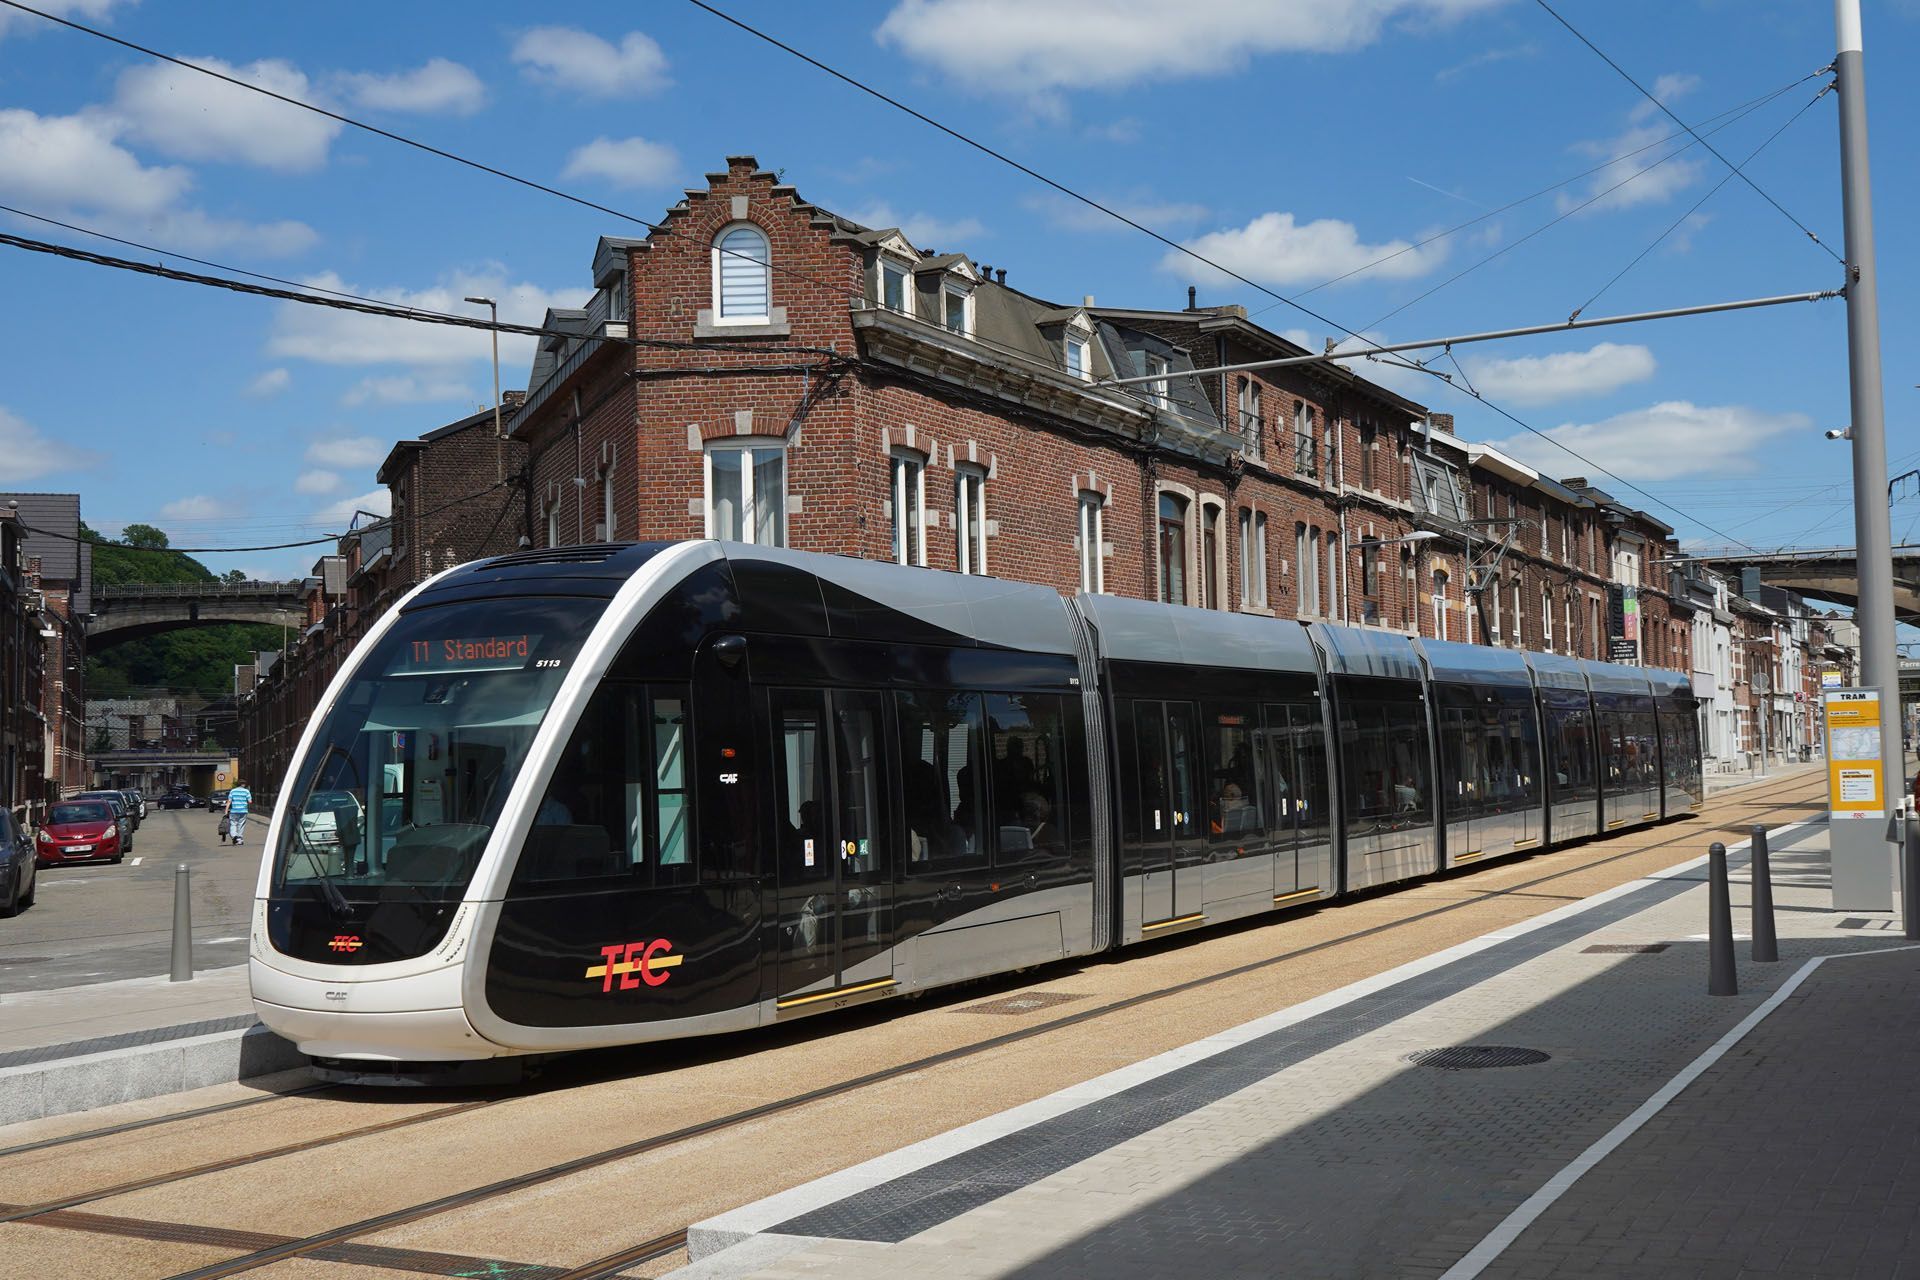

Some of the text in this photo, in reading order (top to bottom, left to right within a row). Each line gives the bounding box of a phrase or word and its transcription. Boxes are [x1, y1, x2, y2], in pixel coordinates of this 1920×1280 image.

[412, 635, 528, 663] T1 Standard
[535, 659, 561, 668] 5113
[719, 773, 738, 784] CAF
[331, 935, 361, 953] TEC
[600, 938, 673, 993] TEC
